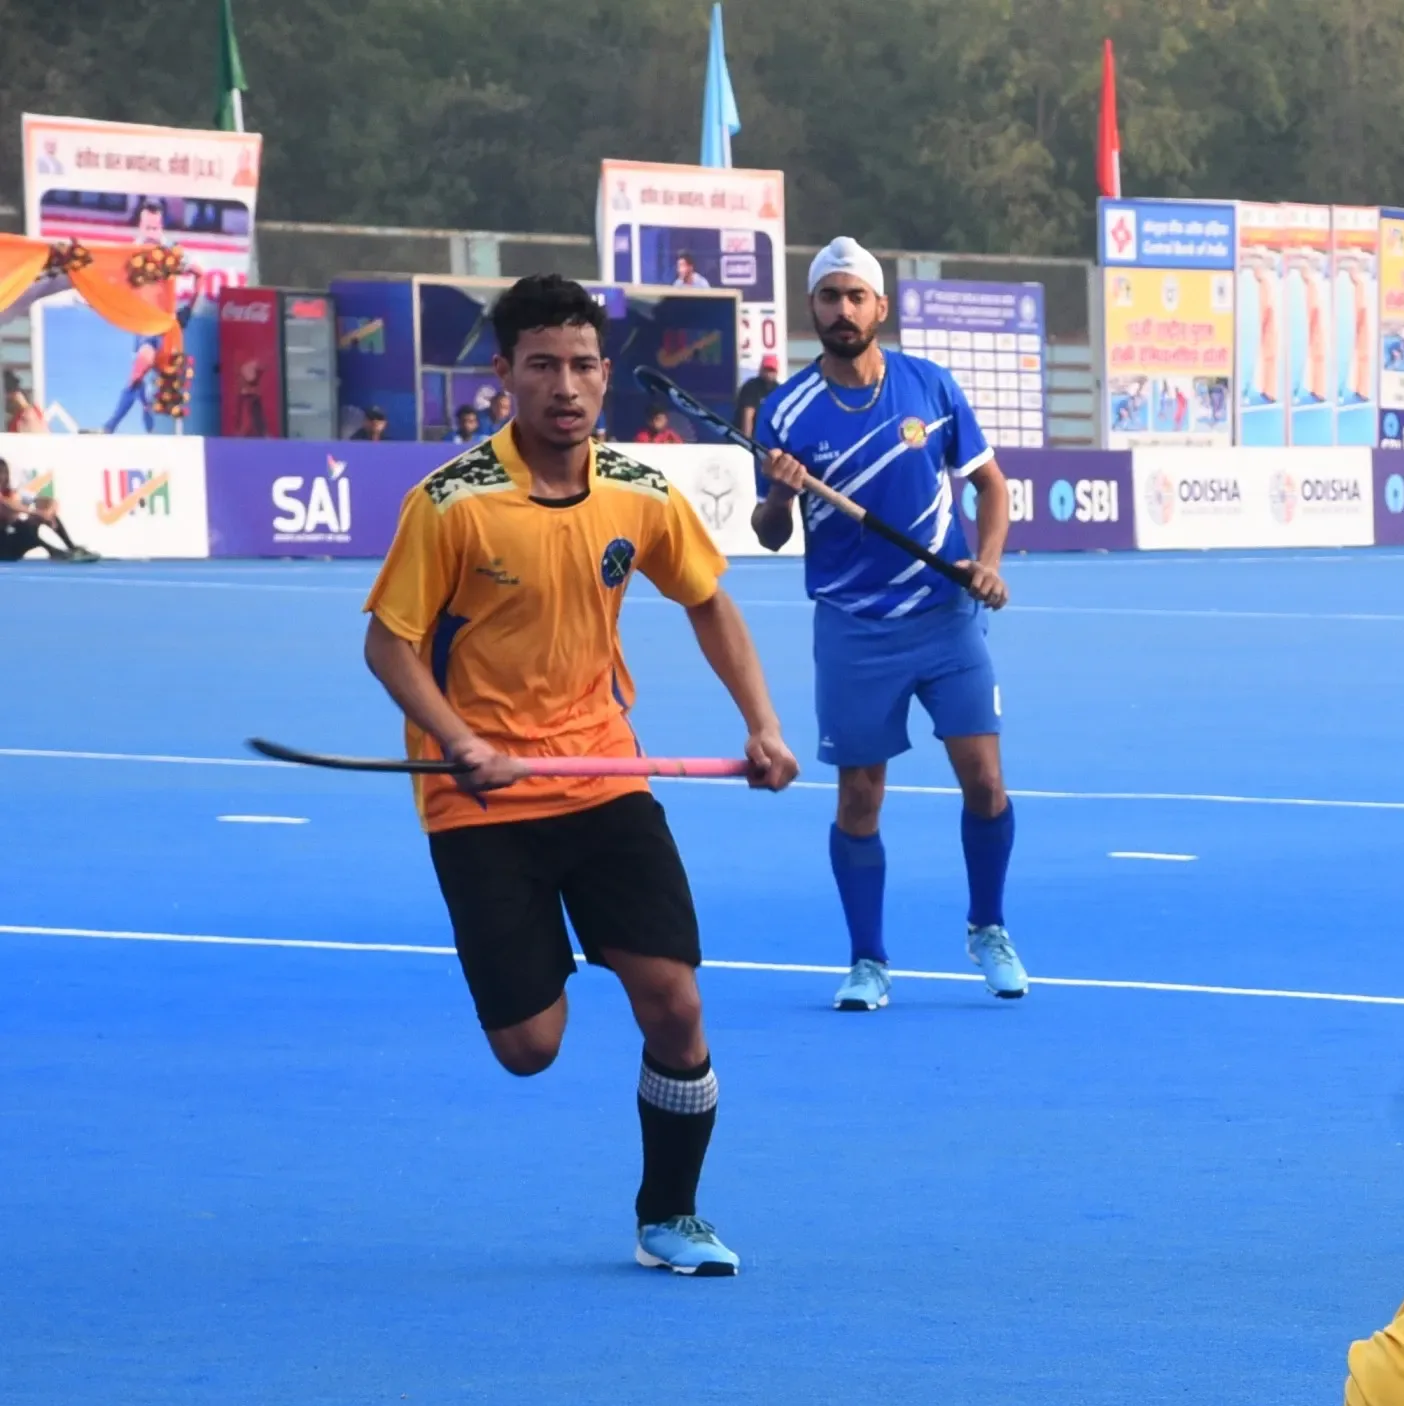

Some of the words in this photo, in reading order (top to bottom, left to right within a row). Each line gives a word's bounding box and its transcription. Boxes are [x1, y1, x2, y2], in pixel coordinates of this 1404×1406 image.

[272, 475, 351, 533] SAI
[1007, 479, 1034, 522] BI
[1075, 480, 1119, 522] SBI
[1179, 479, 1242, 502] ODISHA
[1301, 479, 1362, 502] ODISHA
